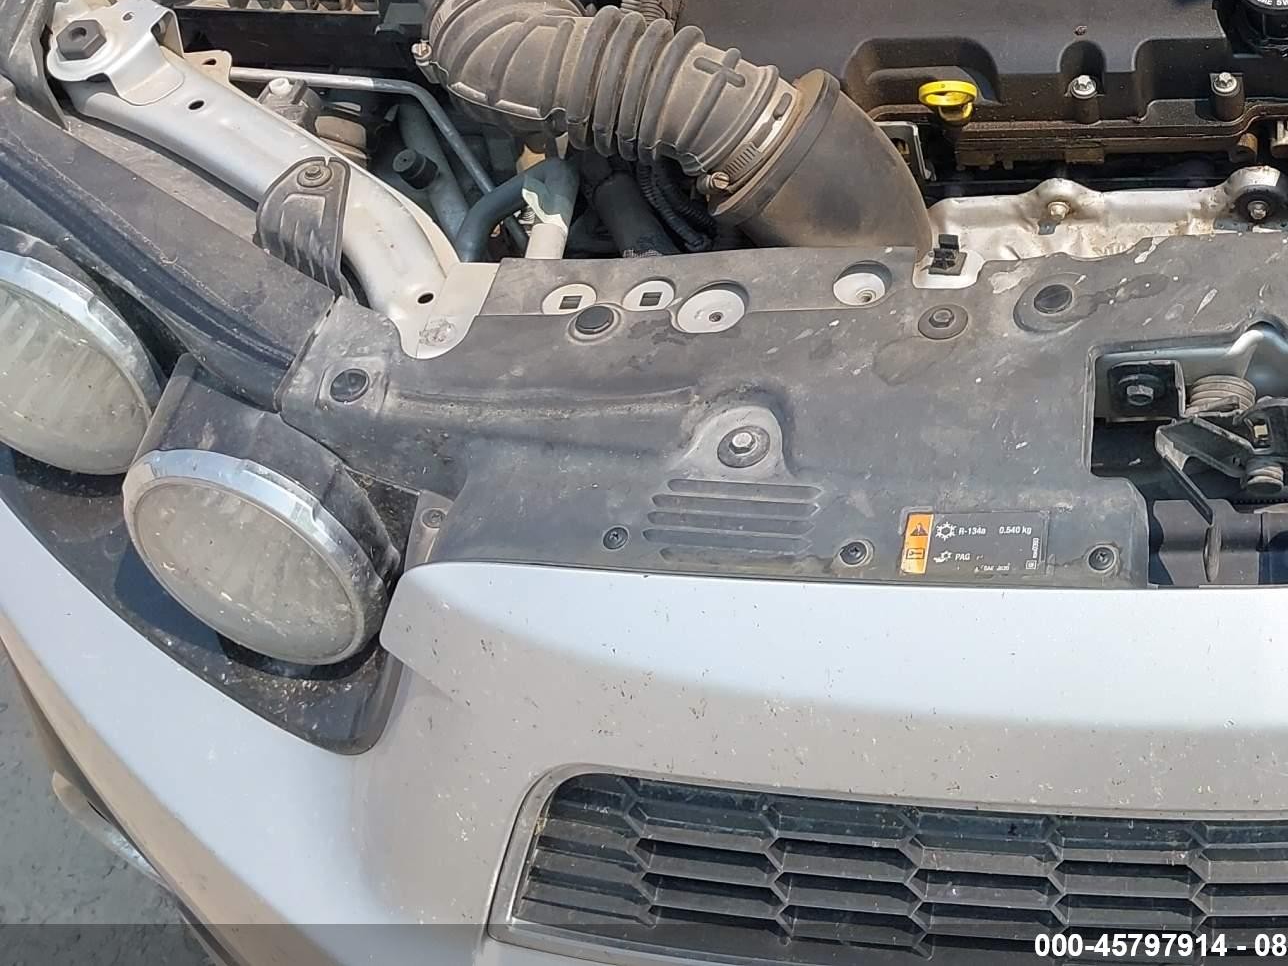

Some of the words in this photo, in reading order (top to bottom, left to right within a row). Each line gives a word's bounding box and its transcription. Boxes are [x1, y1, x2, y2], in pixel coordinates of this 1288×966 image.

[958, 526, 986, 536] R-134a
[999, 525, 1021, 535] 0.540
[1022, 525, 1032, 536] kg
[954, 553, 971, 561] PAG
